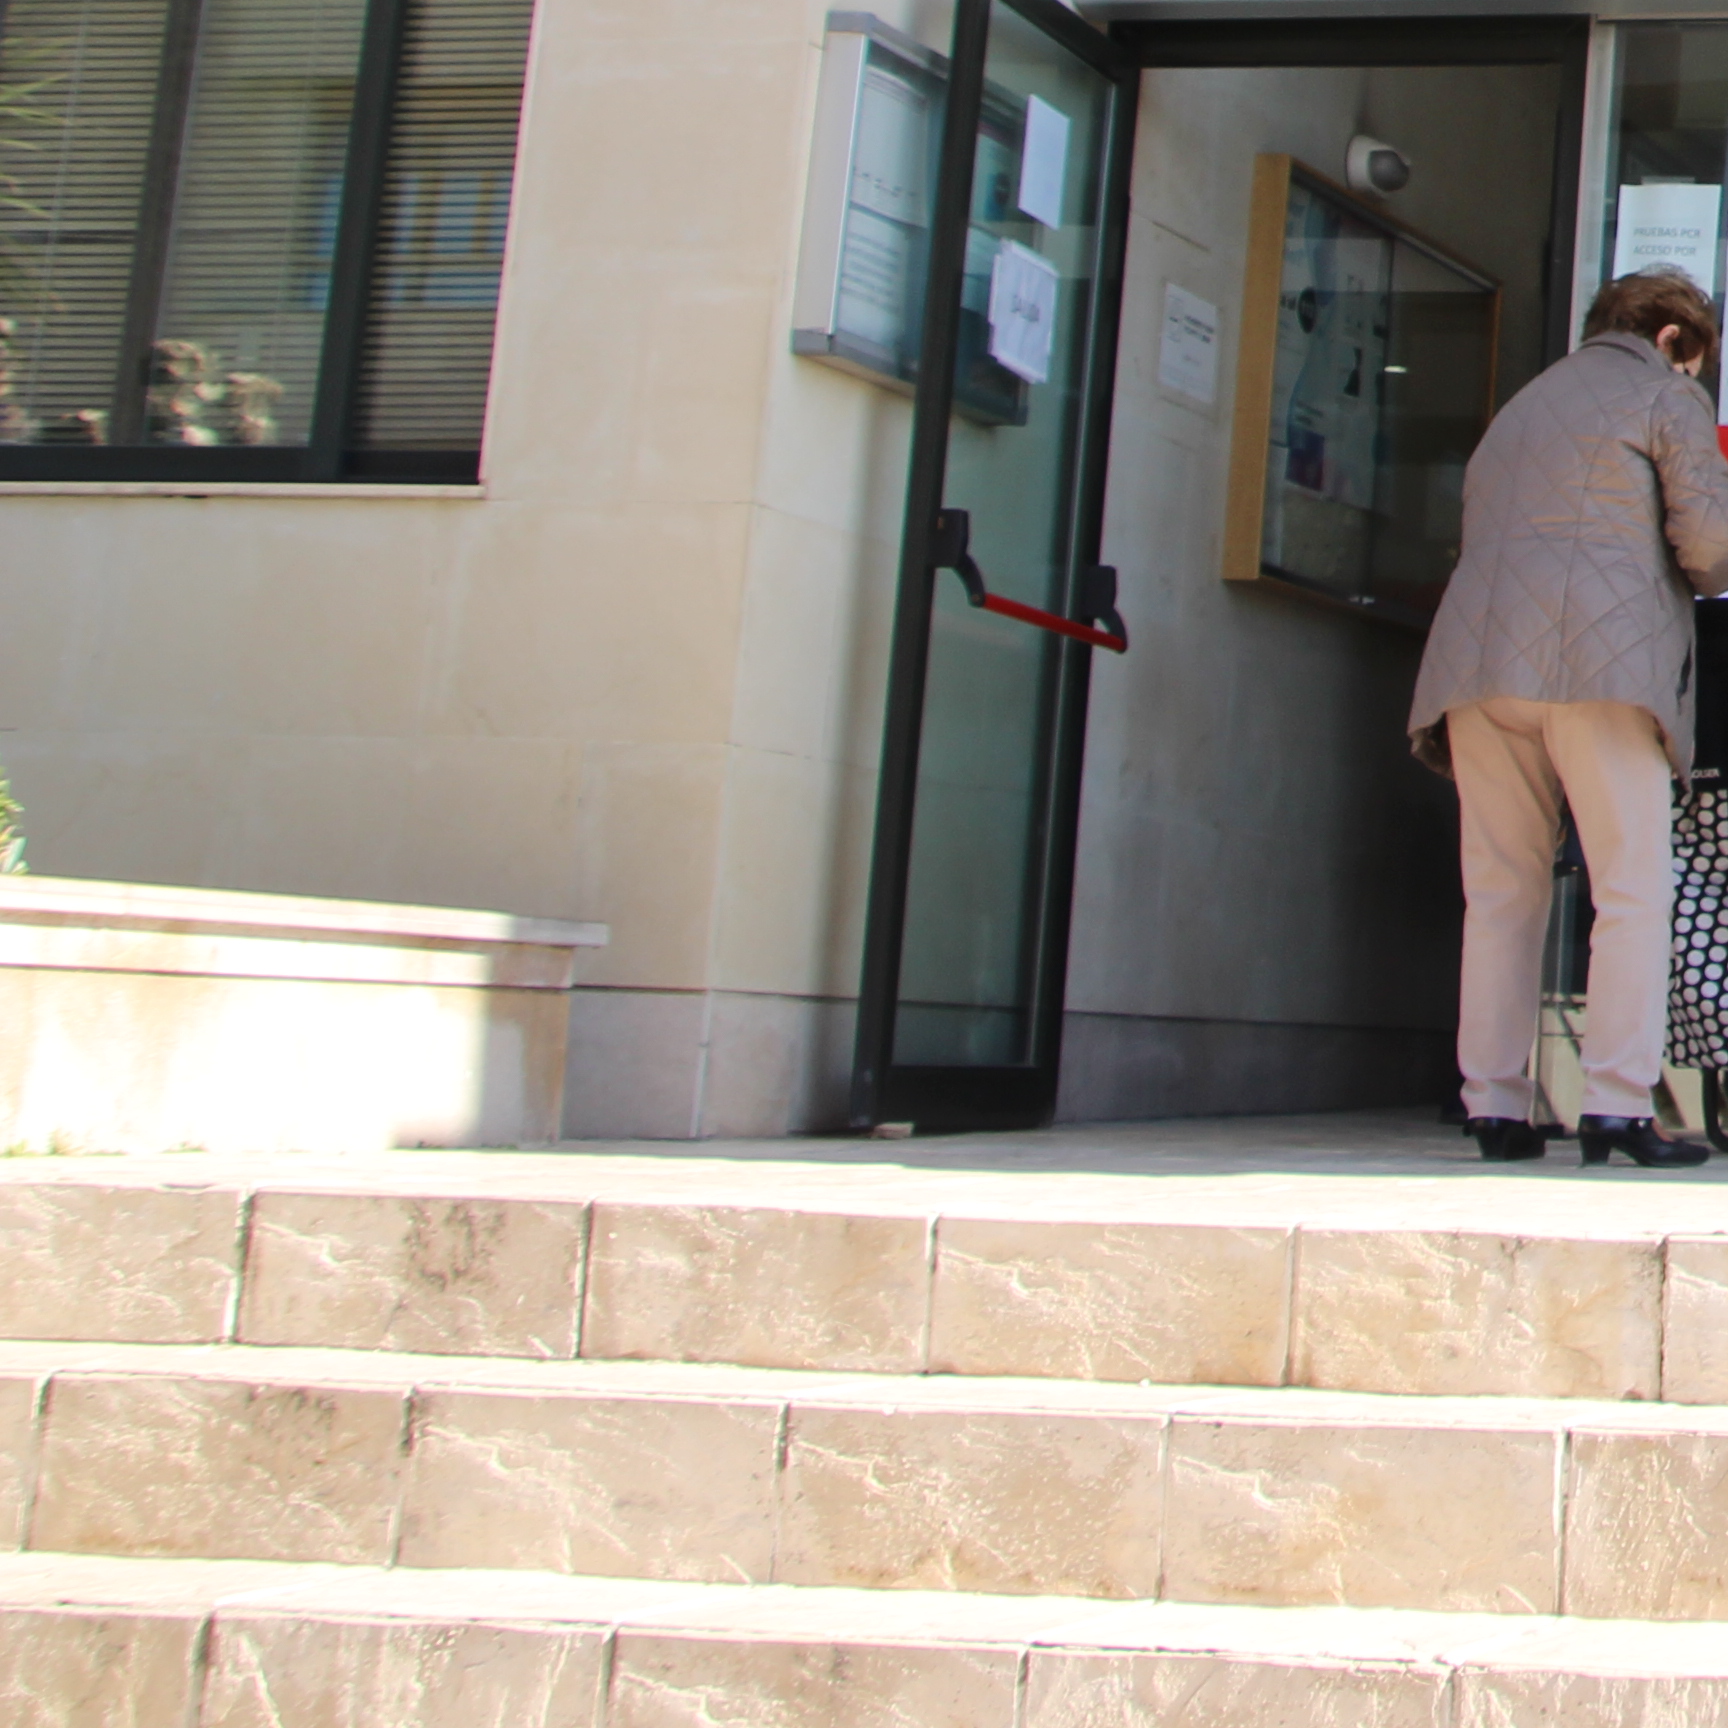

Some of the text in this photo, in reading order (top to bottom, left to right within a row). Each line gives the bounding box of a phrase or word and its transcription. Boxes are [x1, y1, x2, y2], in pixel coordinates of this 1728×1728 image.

[1633, 226, 1700, 239] PRUEBAS PCR
[1632, 244, 1696, 257] ACCESO POR
